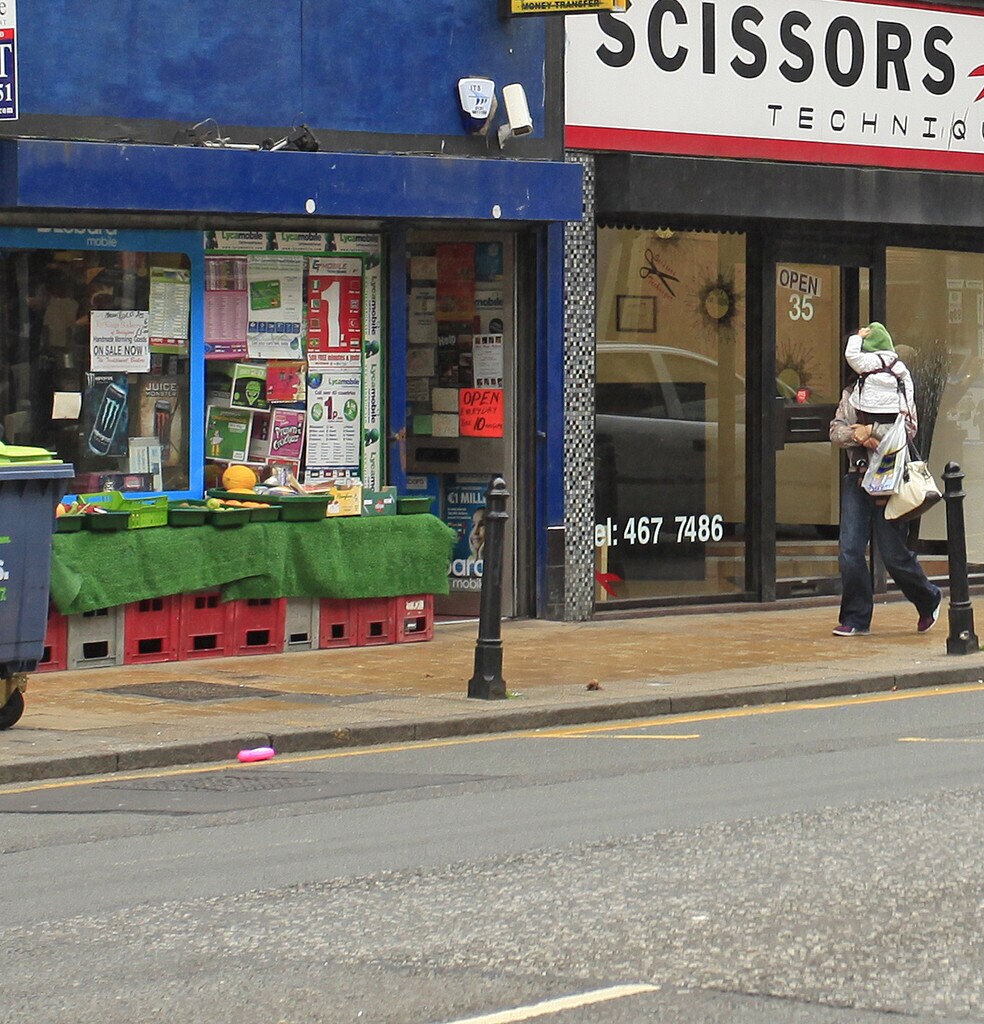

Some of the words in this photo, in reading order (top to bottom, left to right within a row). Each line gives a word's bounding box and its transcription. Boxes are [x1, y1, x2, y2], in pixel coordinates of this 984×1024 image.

[522, 1, 550, 10] MONEY
[555, 0, 600, 9] TRANSFER
[86, 236, 117, 247] mobile
[779, 268, 818, 296] OPEN
[788, 293, 814, 321] 35
[93, 345, 103, 356] ON
[105, 345, 122, 356] SALE
[124, 345, 143, 356] NOW
[145, 382, 177, 391] JUICE
[328, 377, 360, 389] Lycamobile
[463, 391, 500, 406] OPEN
[594, 517, 618, 547] el:
[623, 516, 664, 545] 467
[674, 514, 724, 543] 7486
